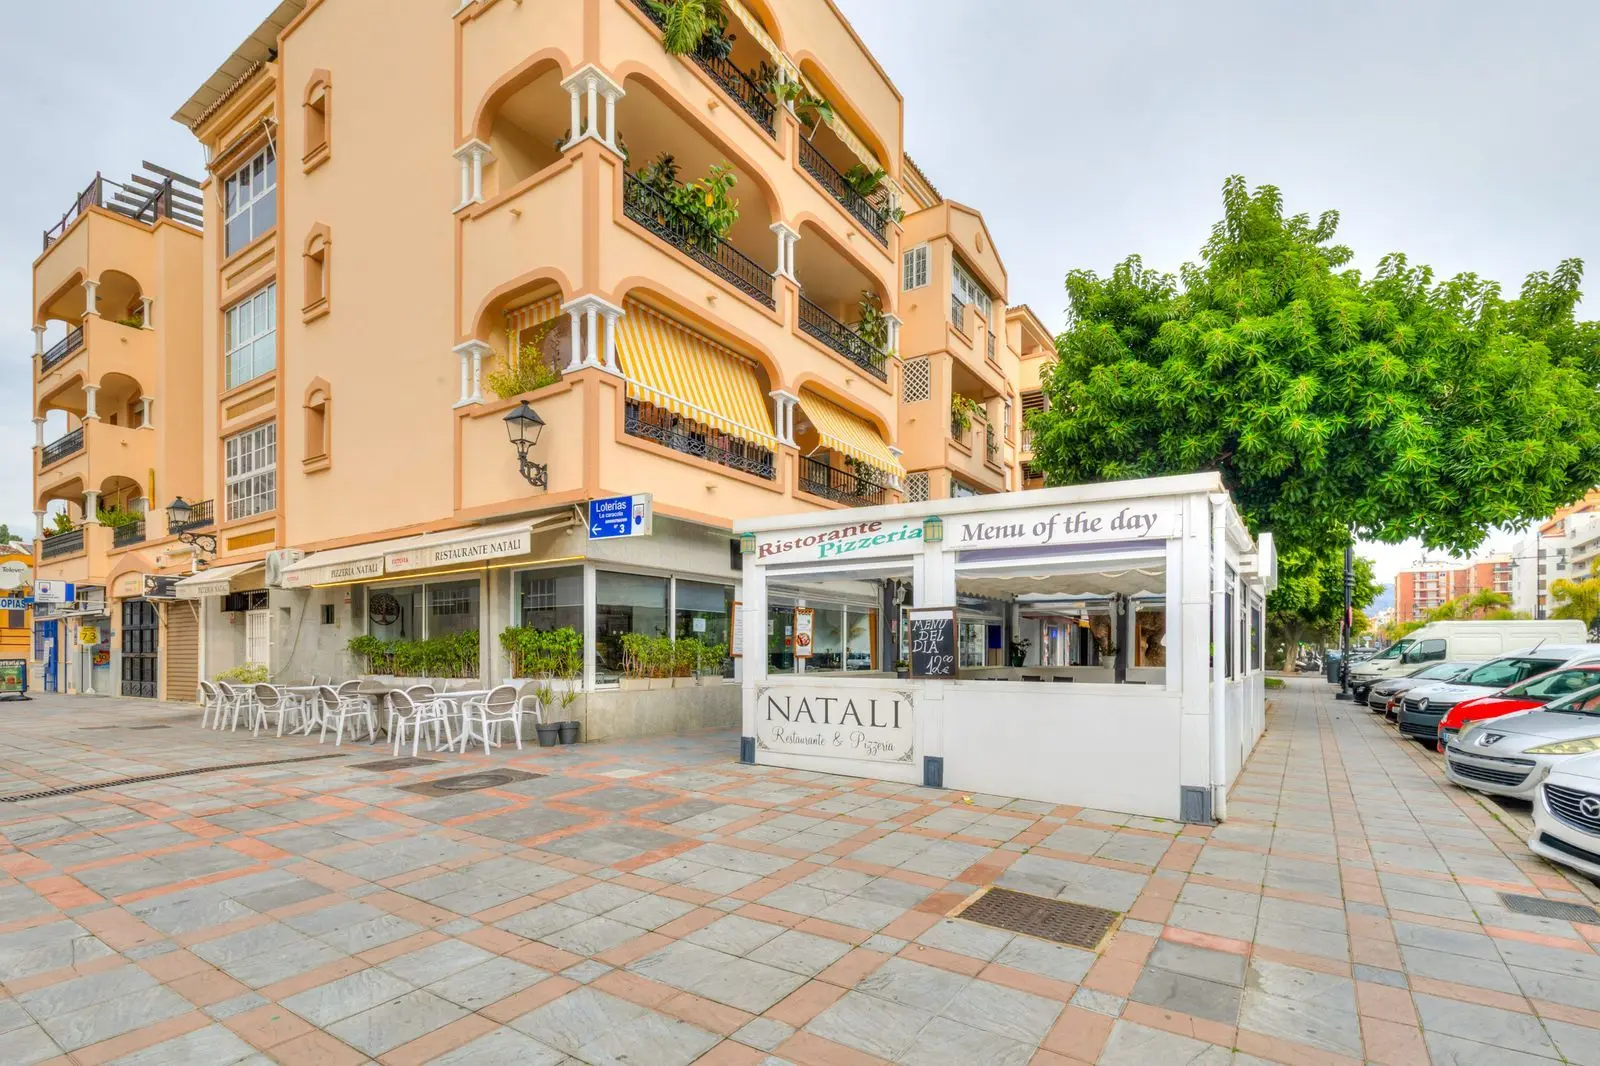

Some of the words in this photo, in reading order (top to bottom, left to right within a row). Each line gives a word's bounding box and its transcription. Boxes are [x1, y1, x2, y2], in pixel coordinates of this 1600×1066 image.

[619, 523, 625, 534] 3
[961, 523, 1025, 541] Menu
[1033, 513, 1060, 544] of
[1063, 511, 1103, 533] the
[1110, 507, 1158, 537] day
[757, 520, 883, 559] Ristorante
[817, 525, 923, 559] Pizzeria
[435, 544, 488, 561] RESTAURANTE
[490, 539, 521, 553] NATALI
[331, 567, 355, 578] PIZZERIA
[356, 563, 378, 574] NATALI
[0, 599, 26, 609] OPIAS
[912, 618, 948, 631] MENU
[919, 629, 945, 642] DEL
[912, 640, 940, 654] DIA
[765, 695, 902, 729] NATALI
[771, 725, 826, 747] Restaurante
[832, 731, 844, 747] &
[850, 729, 896, 757] Pizzeria
